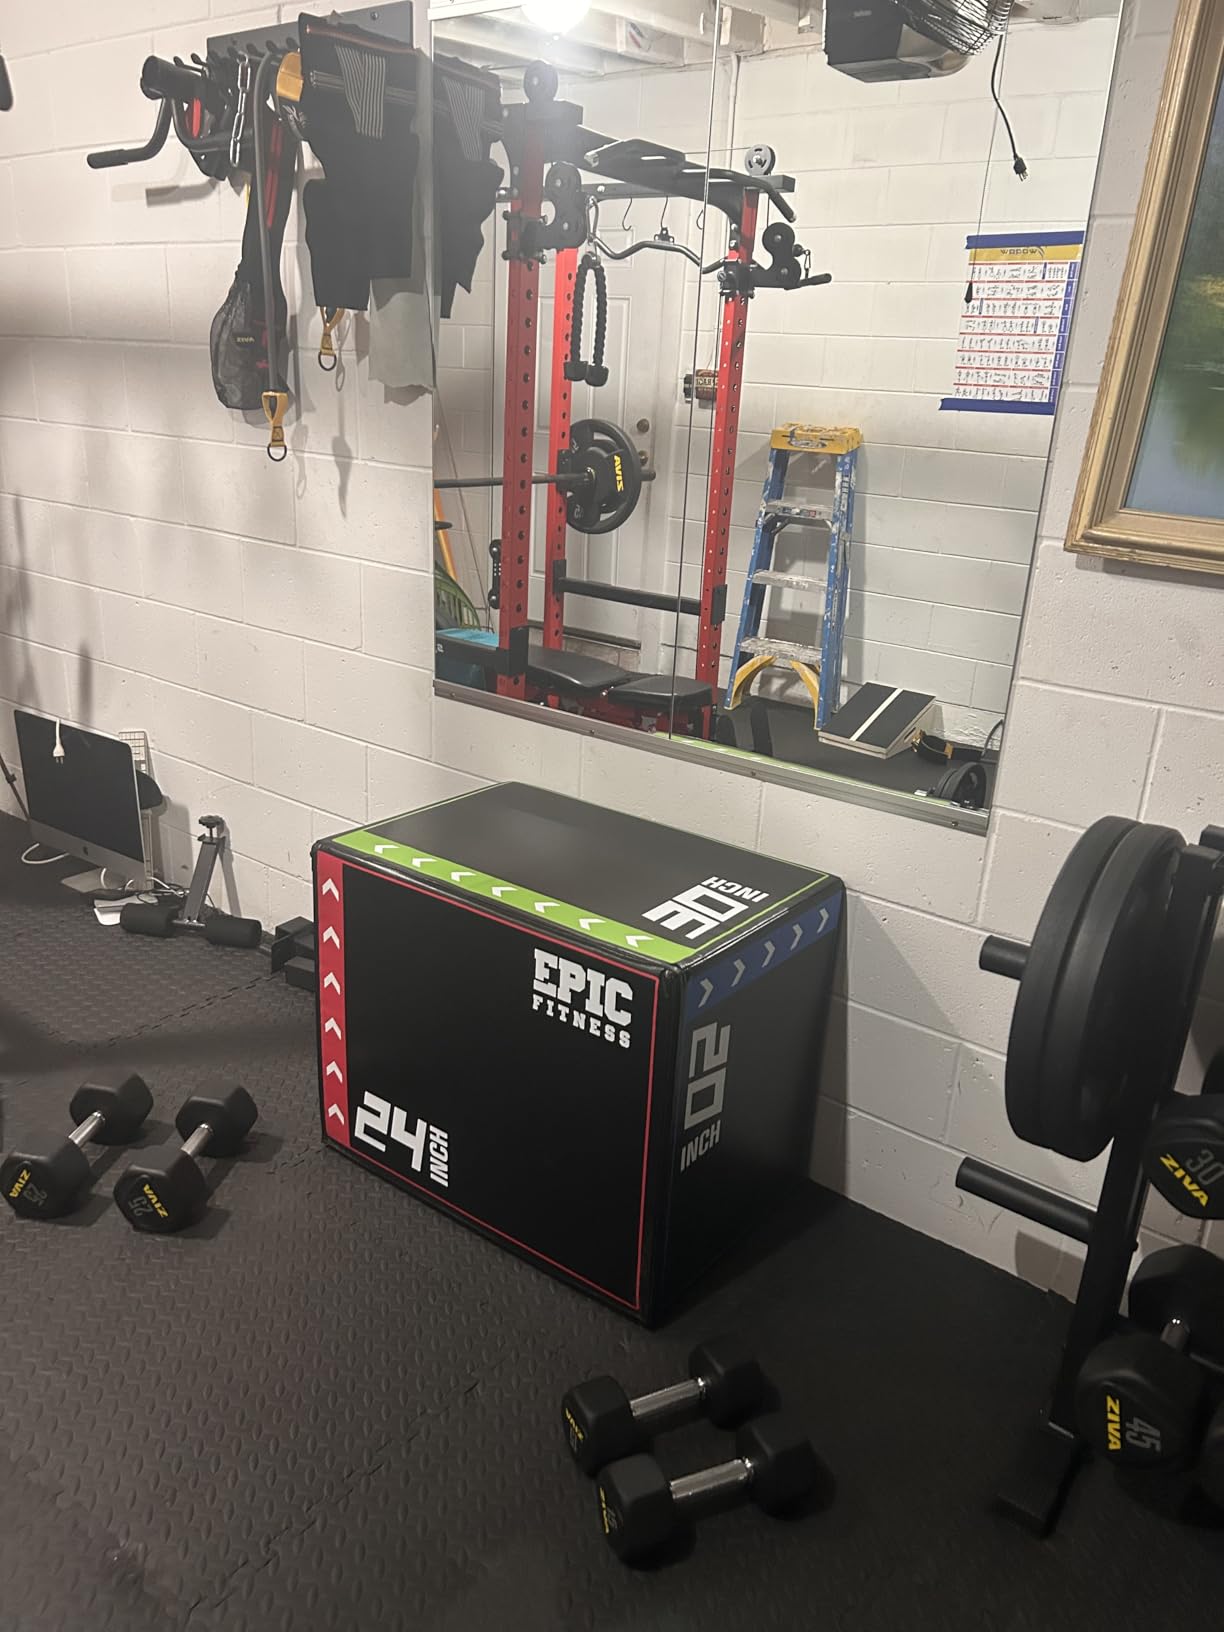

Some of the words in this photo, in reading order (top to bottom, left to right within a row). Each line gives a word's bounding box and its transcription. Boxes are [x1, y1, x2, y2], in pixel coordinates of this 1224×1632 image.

[641, 885, 750, 940] 30
[700, 876, 770, 903] INCH
[533, 948, 633, 1027] EPIC
[532, 993, 631, 1049] FITNESS
[684, 1022, 731, 1131] 20
[354, 1090, 427, 1172] 24
[429, 1124, 449, 1188] INCH
[680, 1119, 721, 1173] INCH
[9, 1169, 32, 1198] ZIVA
[1159, 1153, 1209, 1207] ZIVA
[1185, 1149, 1224, 1185] 30
[24, 1183, 47, 1207] 25
[127, 1196, 154, 1216] 25
[143, 1183, 169, 1218] ZIVA
[1105, 1394, 1122, 1451] ZIVA
[1124, 1416, 1161, 1452] 45
